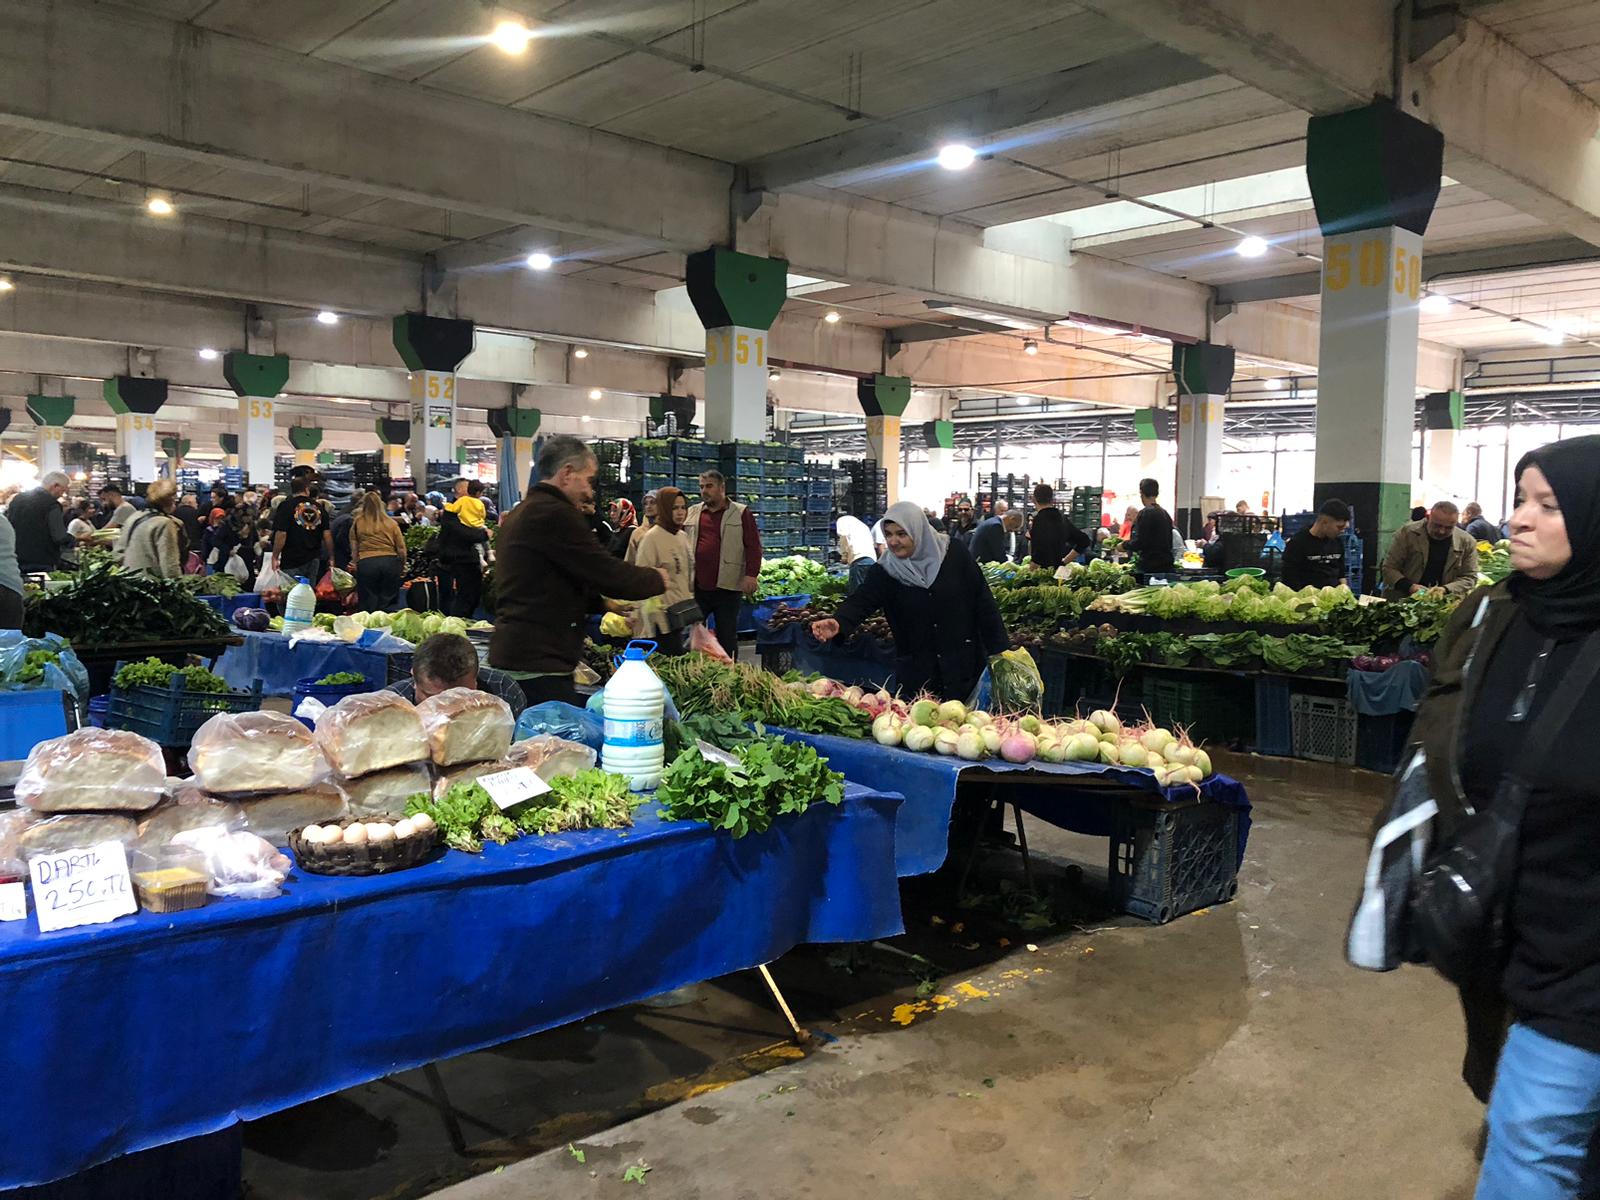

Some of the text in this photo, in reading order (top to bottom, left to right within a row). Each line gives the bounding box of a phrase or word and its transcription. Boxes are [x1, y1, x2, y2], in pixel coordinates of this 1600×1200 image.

[1326, 240, 1385, 292] 50
[1395, 246, 1420, 301] 50
[706, 335, 730, 366] 51
[736, 334, 763, 368] 51
[428, 375, 454, 399] 52
[134, 415, 154, 431] 54
[250, 400, 273, 418] 53
